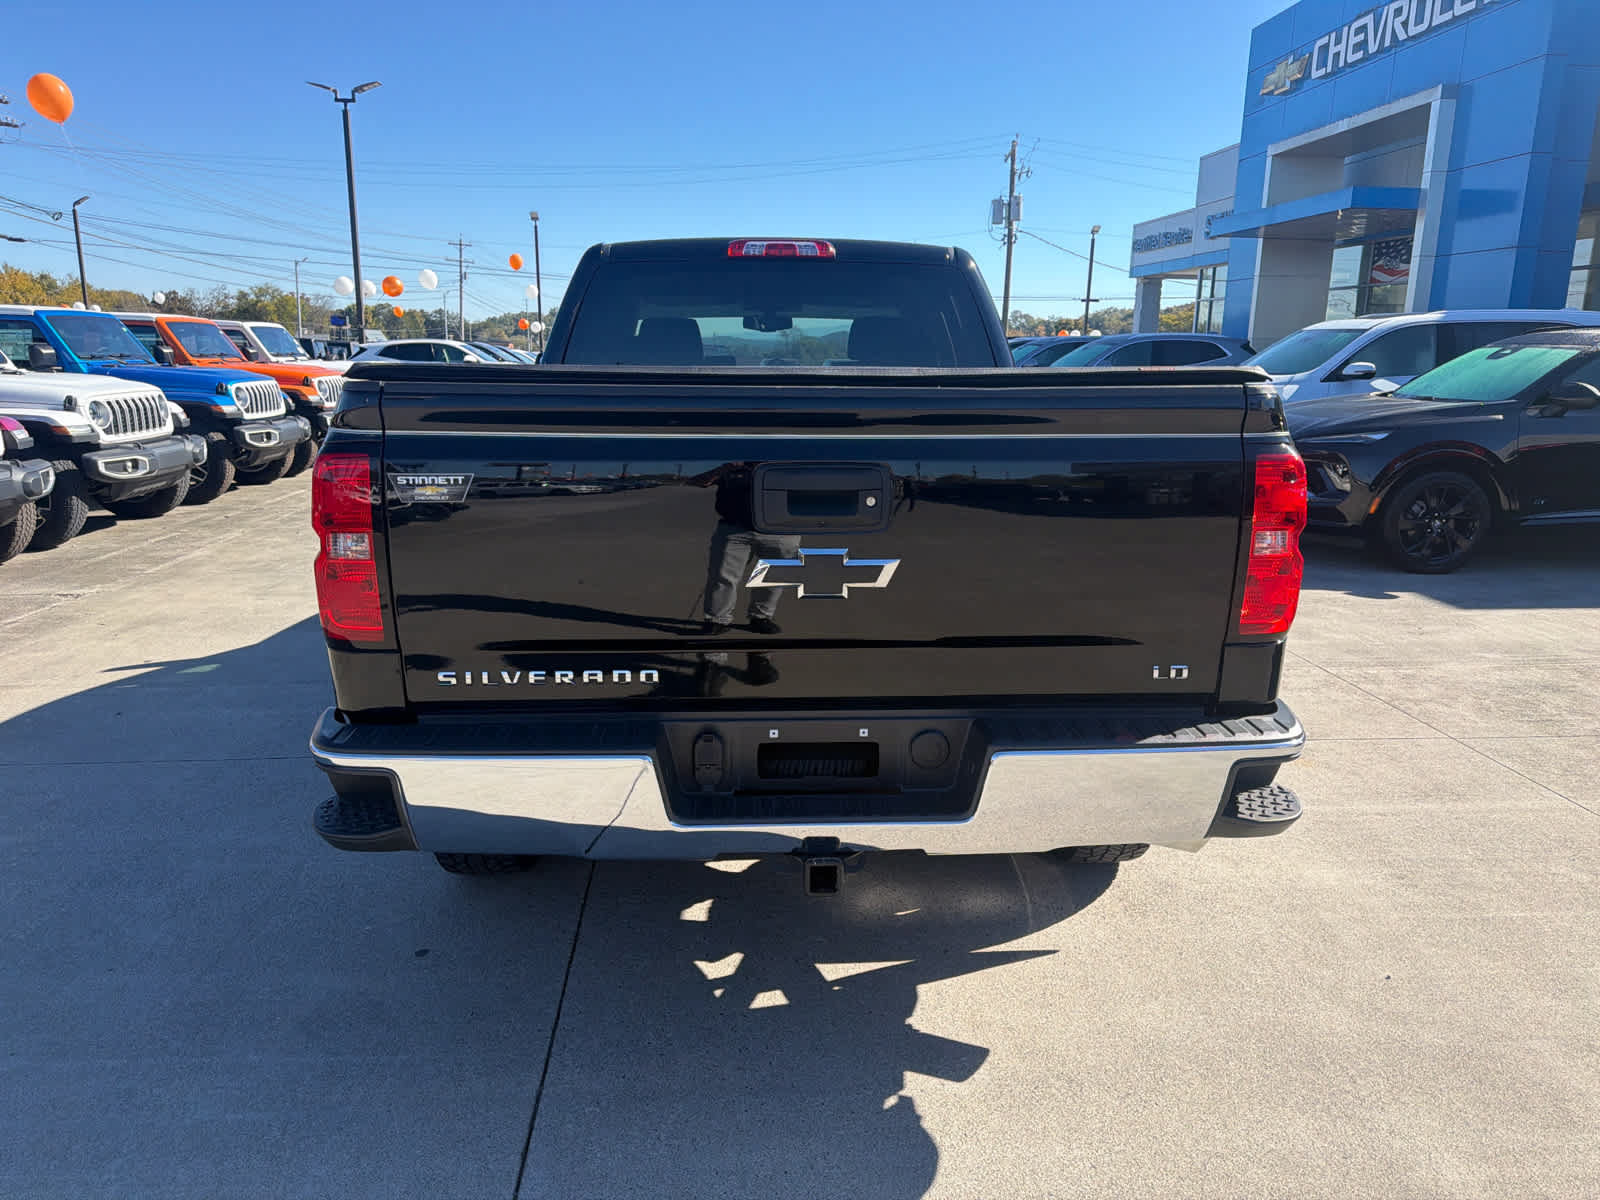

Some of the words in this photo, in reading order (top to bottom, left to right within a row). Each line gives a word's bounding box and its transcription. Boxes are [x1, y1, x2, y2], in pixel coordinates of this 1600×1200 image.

[1311, 0, 1491, 80] CHEVROL
[397, 476, 464, 484] STINNETT
[437, 669, 659, 686] SILVERADO
[1152, 665, 1189, 680] LD
